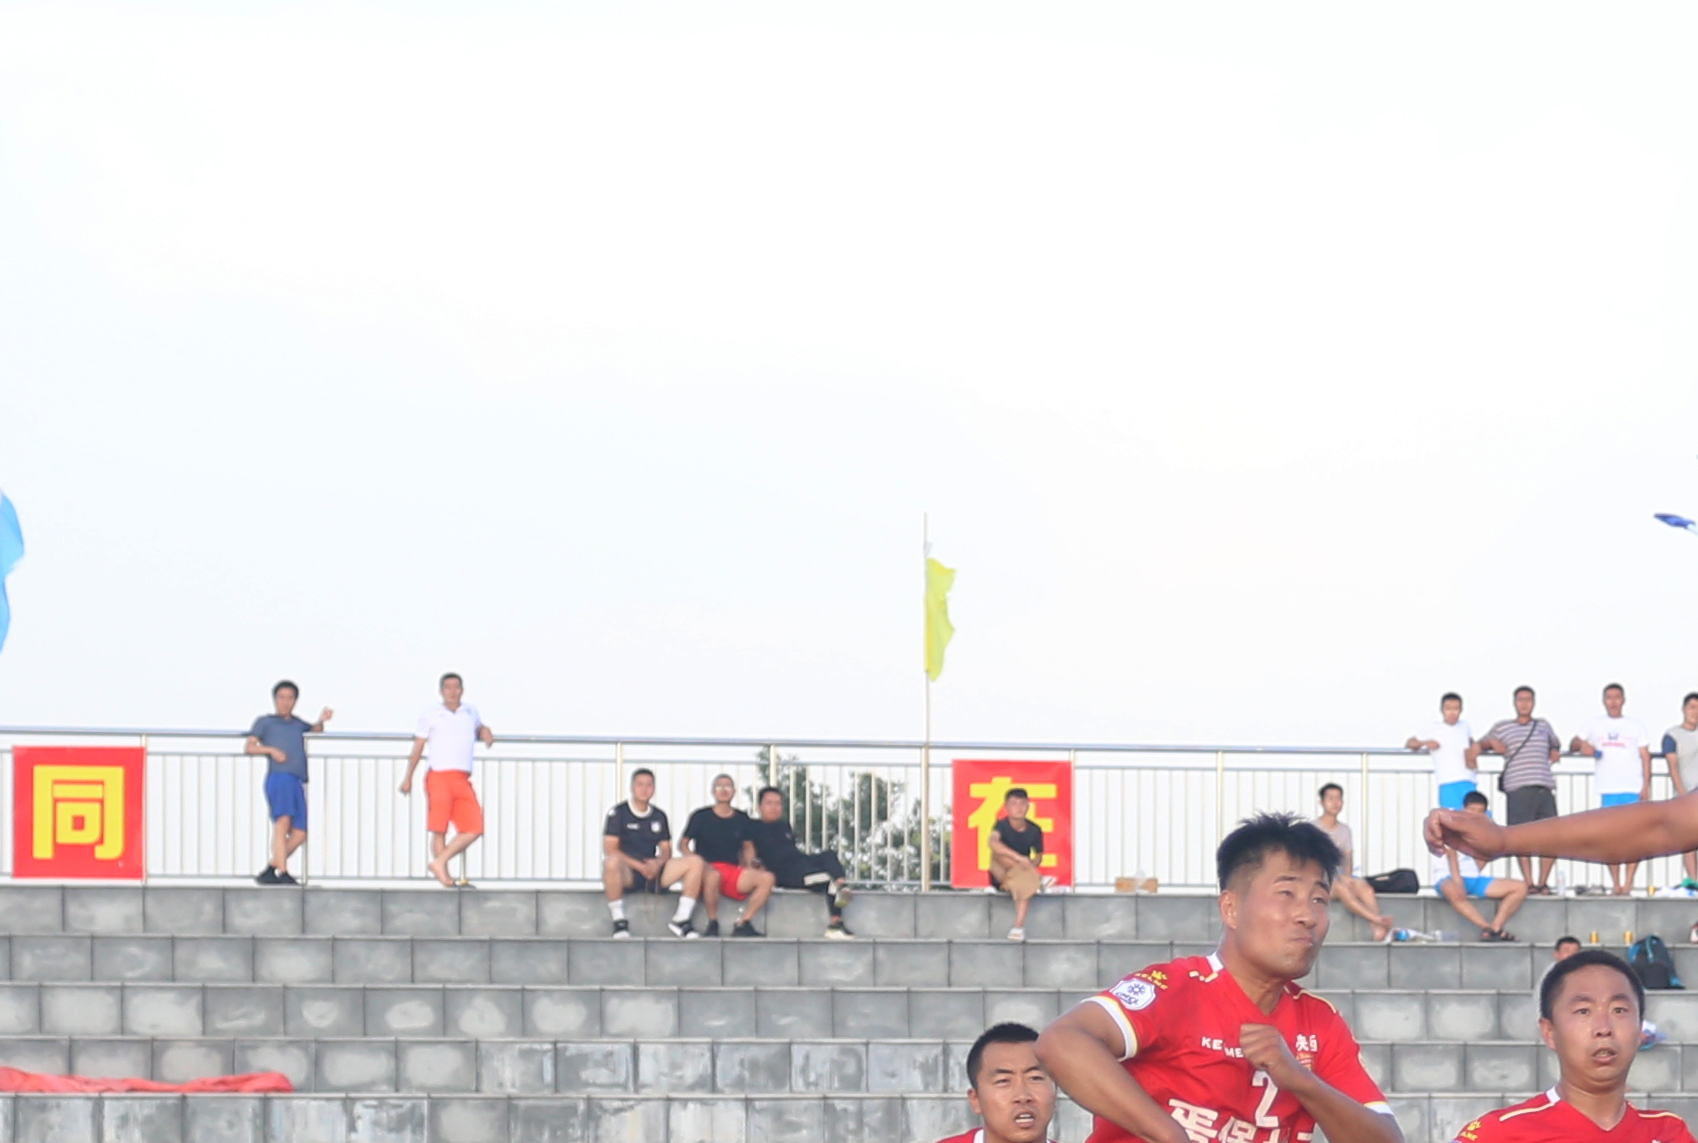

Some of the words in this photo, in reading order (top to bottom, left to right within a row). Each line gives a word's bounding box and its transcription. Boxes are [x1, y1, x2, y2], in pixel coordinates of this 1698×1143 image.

[33, 765, 124, 860] 同
[967, 776, 1057, 871] 在
[1201, 1036, 1244, 1058] KEME
[1252, 1070, 1279, 1128] 2
